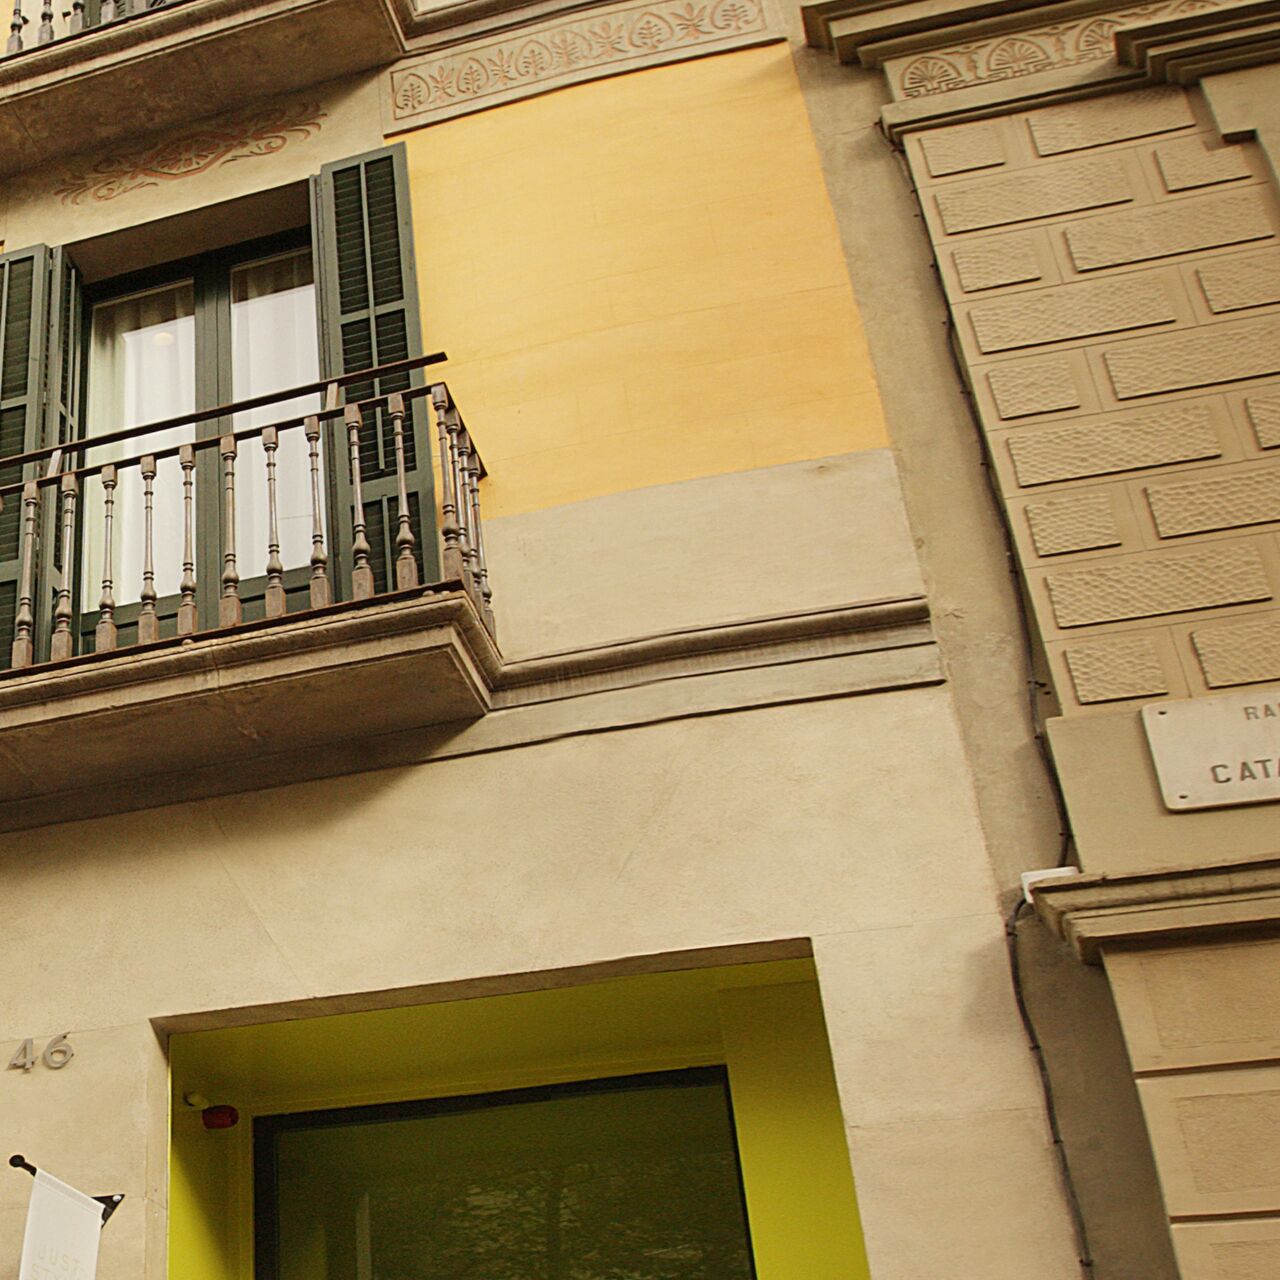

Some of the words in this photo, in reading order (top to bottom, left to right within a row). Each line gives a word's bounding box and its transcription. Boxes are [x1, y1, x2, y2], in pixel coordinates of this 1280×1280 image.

[1243, 703, 1280, 721] RA
[1210, 757, 1280, 784] CAT
[6, 1031, 74, 1074] 46
